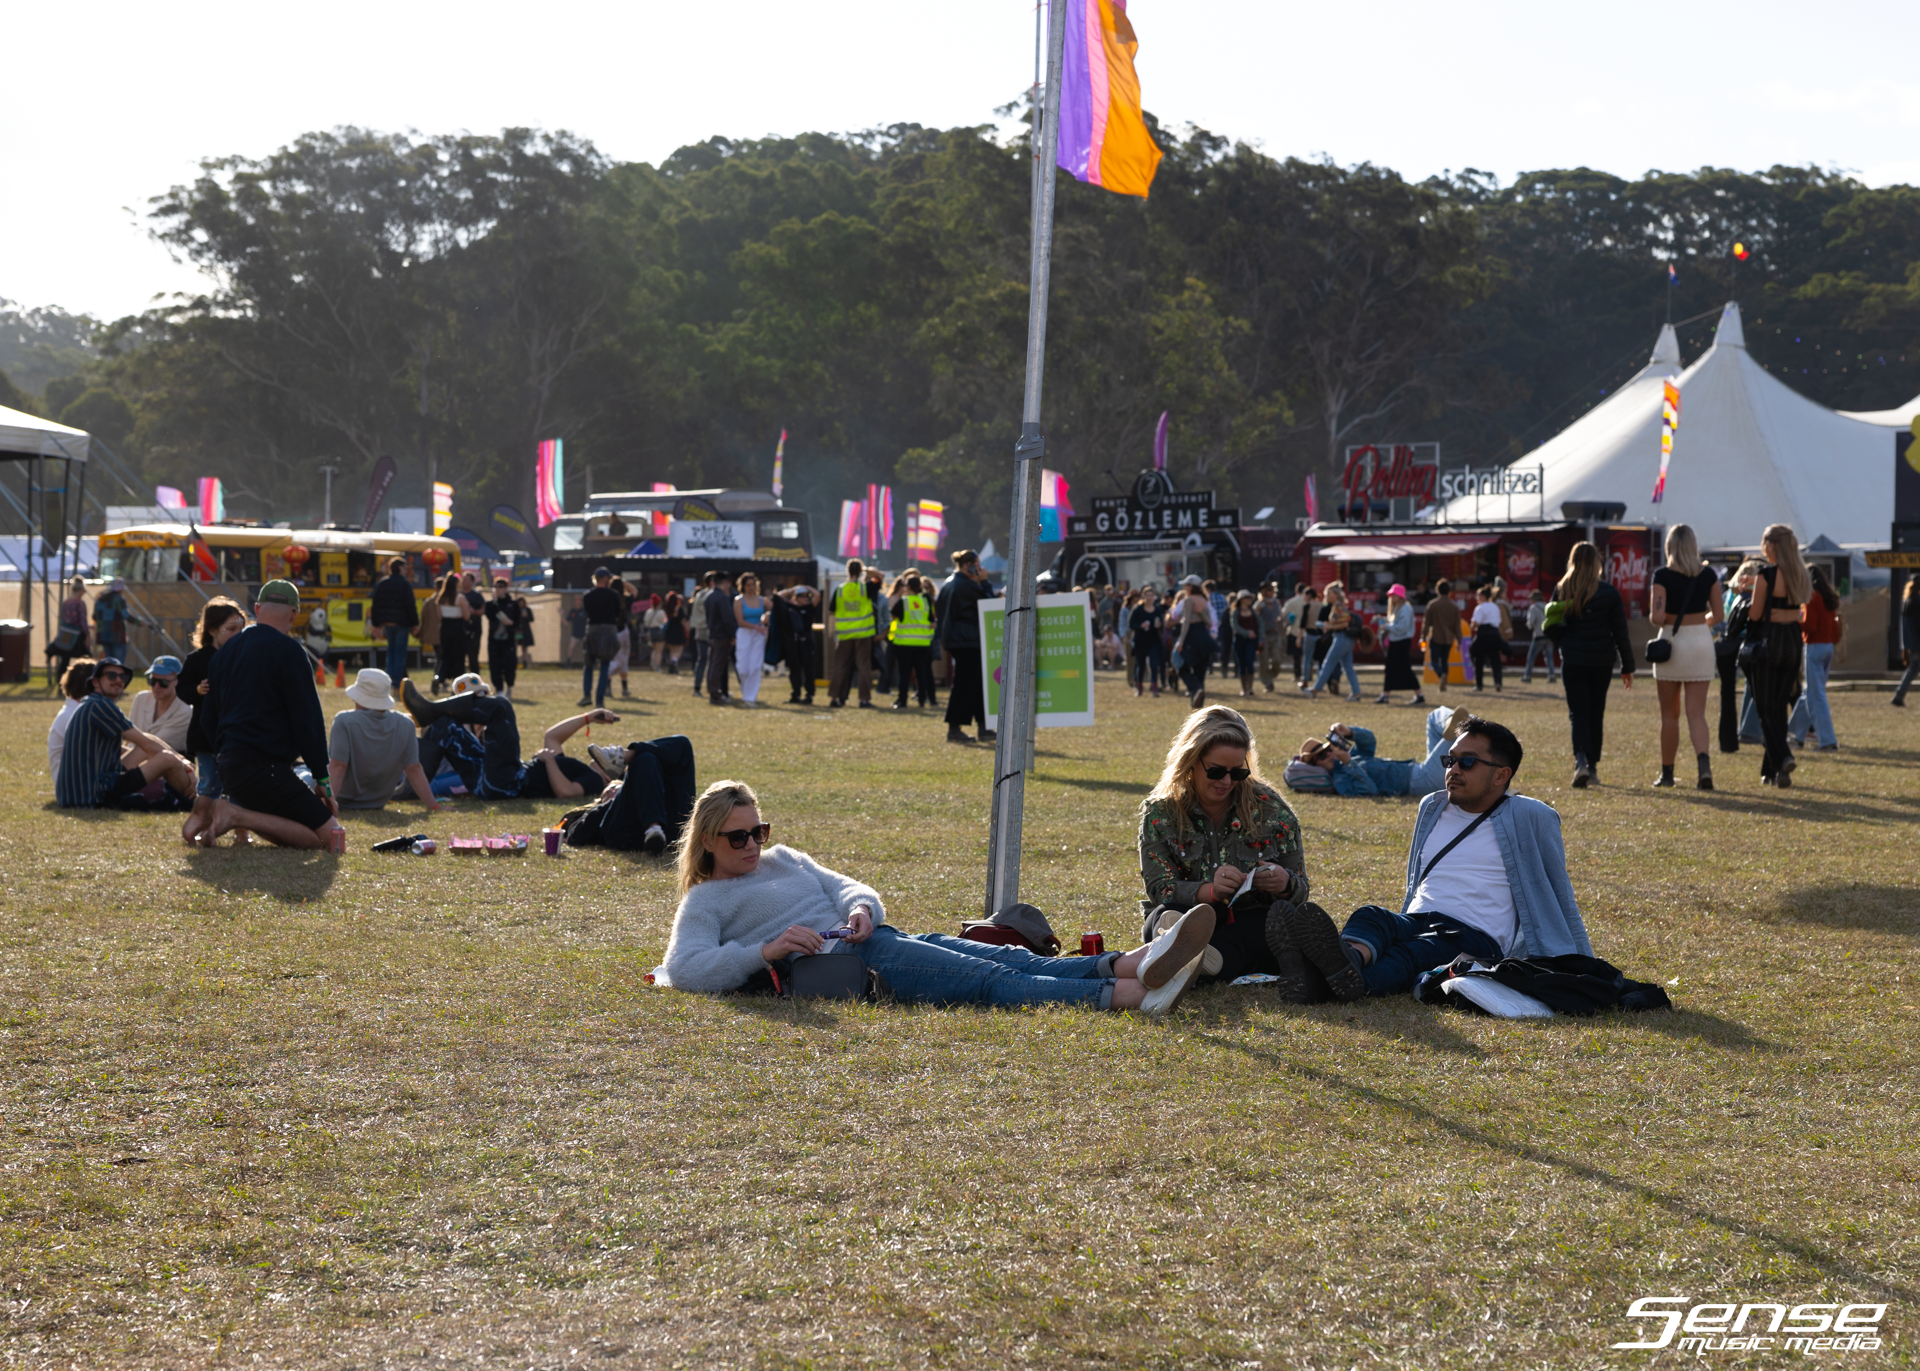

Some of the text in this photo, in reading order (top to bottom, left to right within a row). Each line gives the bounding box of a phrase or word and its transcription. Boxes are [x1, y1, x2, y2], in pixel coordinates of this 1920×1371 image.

[1342, 444, 1437, 523] Rolling
[1162, 494, 1209, 505] GOURMET
[1096, 508, 1209, 532] GÖZLEME
[1047, 645, 1082, 656] NERVES
